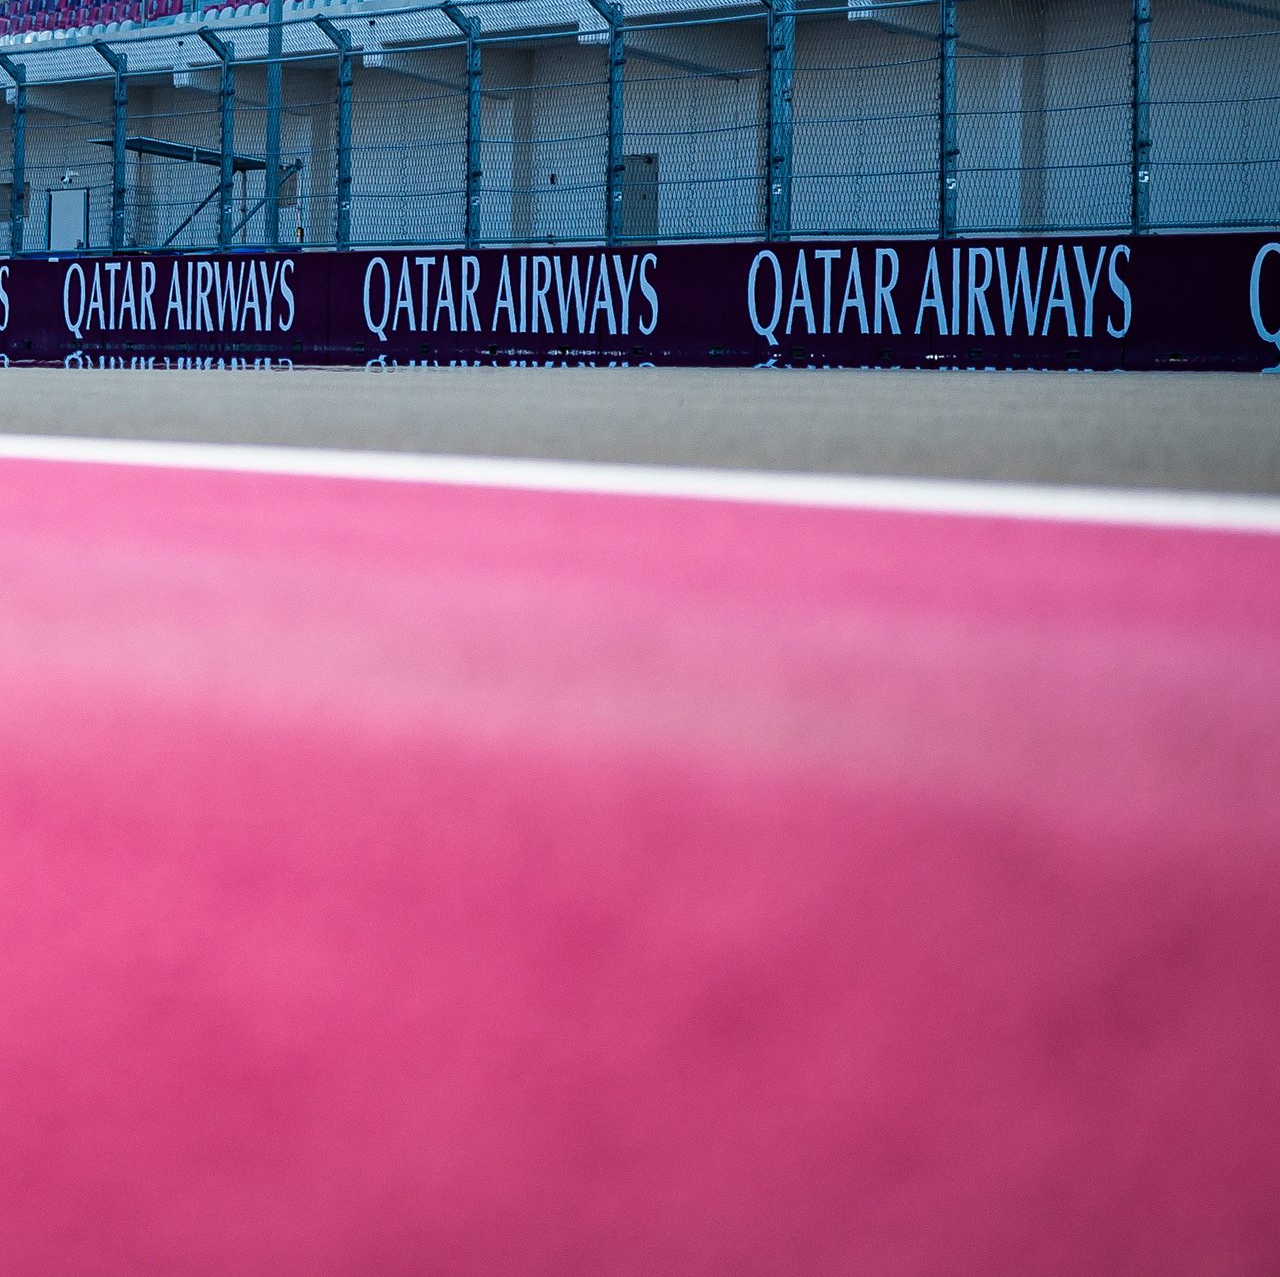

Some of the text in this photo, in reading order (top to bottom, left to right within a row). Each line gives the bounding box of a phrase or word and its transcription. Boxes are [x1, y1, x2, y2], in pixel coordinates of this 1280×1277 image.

[64, 259, 294, 339] QATAR AIRWAYS
[363, 253, 658, 341] QATAR AIRWAYS
[748, 244, 1132, 346] QATAR AIRWAYS
